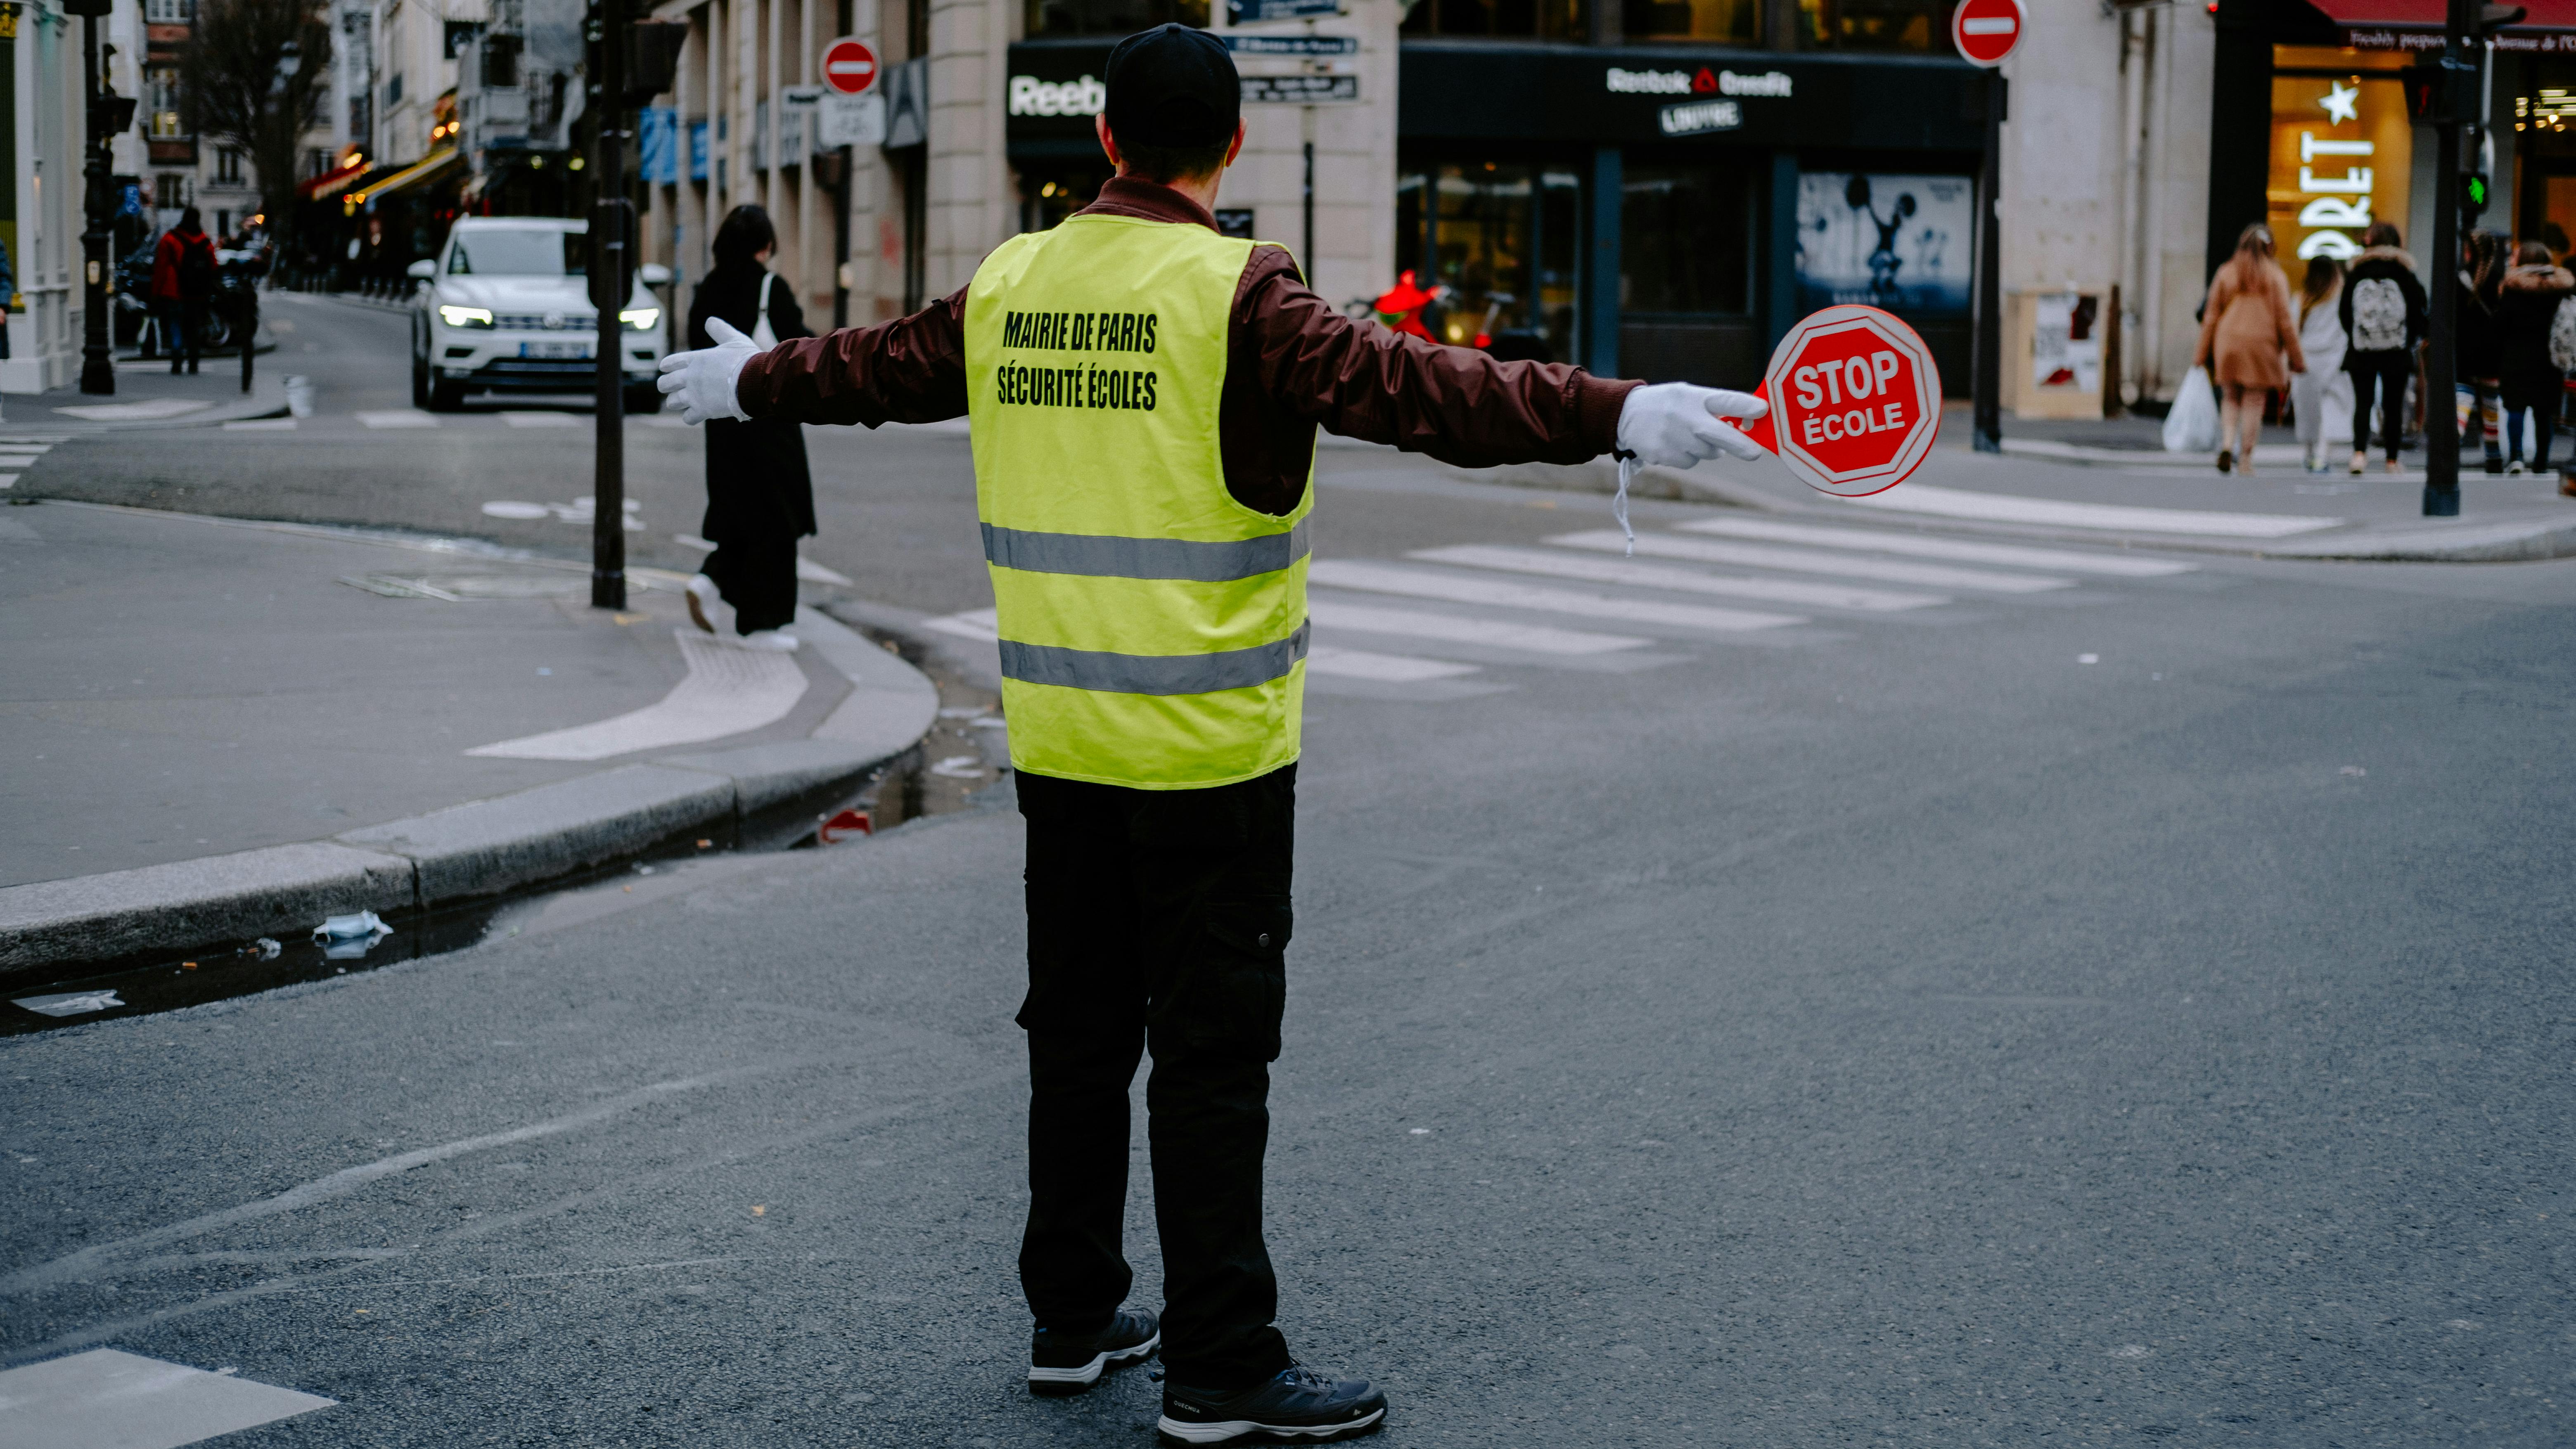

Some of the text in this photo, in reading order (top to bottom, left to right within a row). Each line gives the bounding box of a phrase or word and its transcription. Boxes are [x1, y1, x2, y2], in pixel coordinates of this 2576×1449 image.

[1010, 74, 1106, 116] Reeb
[1607, 68, 1692, 94] Reebok
[1661, 102, 1739, 133] LOUVRE
[2297, 130, 2375, 261] PRET
[1003, 311, 1157, 354] MAIRIE DE PARIS
[998, 360, 1157, 411] SÉCURITÉ ÉCOLES
[1794, 350, 1899, 409] STOP
[1803, 402, 1905, 445] ÉCOLE
[1174, 1400, 1200, 1413] QUECHUA
